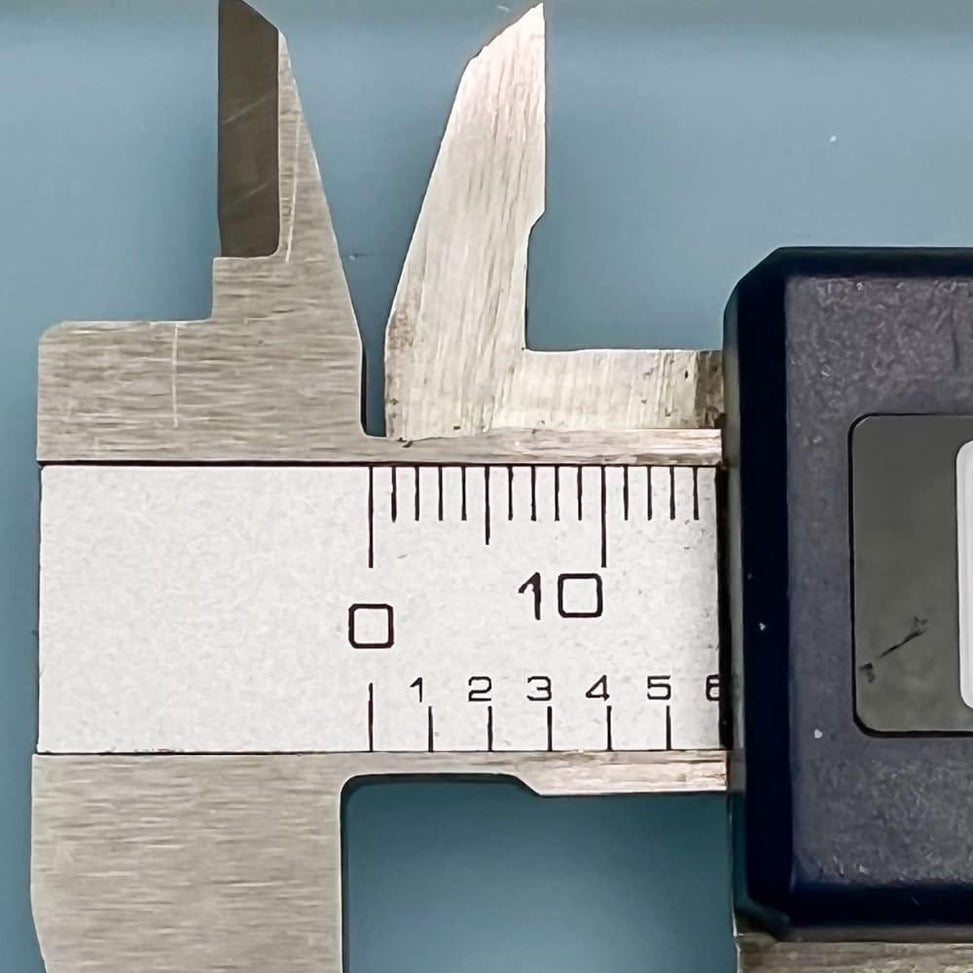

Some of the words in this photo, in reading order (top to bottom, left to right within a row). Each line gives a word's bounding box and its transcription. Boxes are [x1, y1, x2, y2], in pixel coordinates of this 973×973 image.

[517, 571, 604, 621] 10
[347, 603, 395, 649] 0
[409, 676, 424, 703] 1
[467, 675, 493, 702] 2
[526, 675, 553, 702] 3
[584, 674, 611, 702] 4
[646, 674, 672, 701] 5
